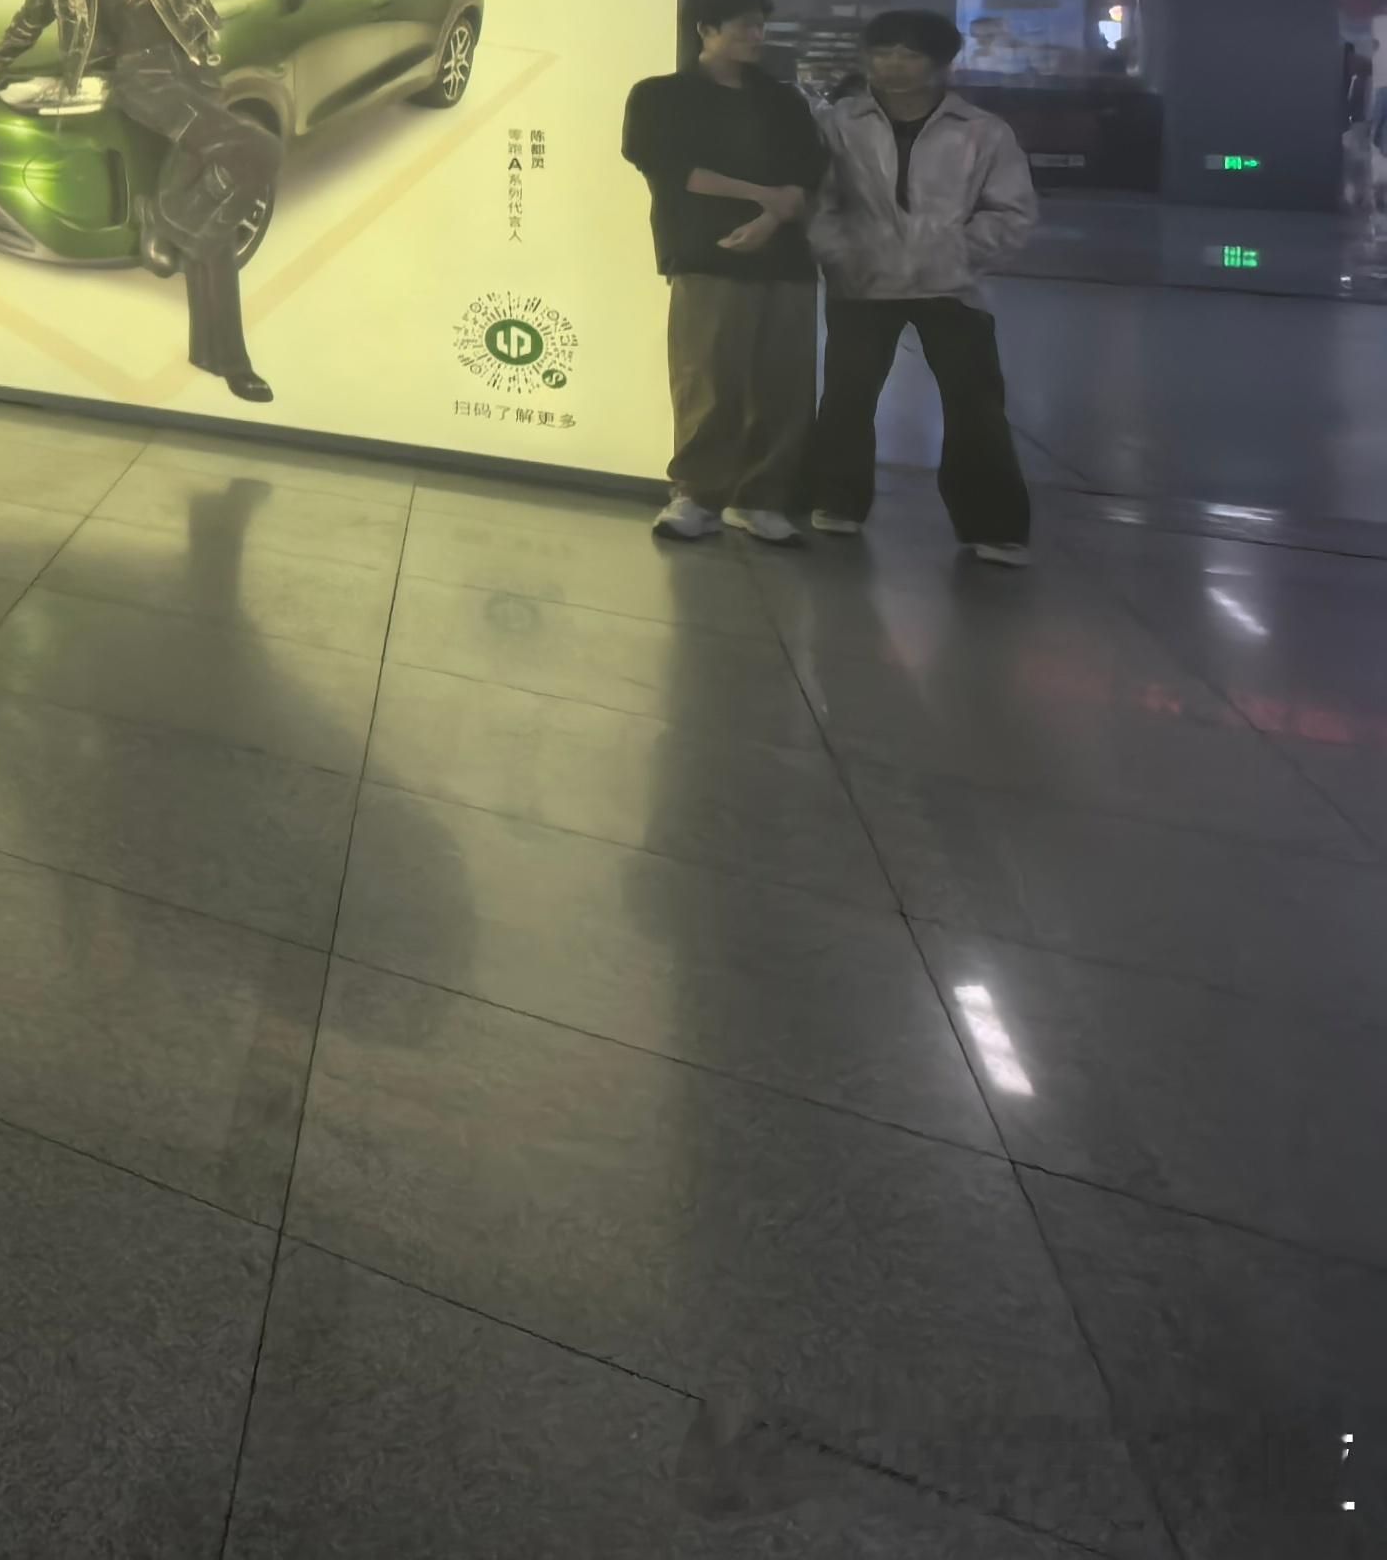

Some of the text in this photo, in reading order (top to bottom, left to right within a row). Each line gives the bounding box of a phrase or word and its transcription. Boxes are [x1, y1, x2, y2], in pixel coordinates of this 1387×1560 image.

[453, 398, 577, 428] 扫码了解更多
